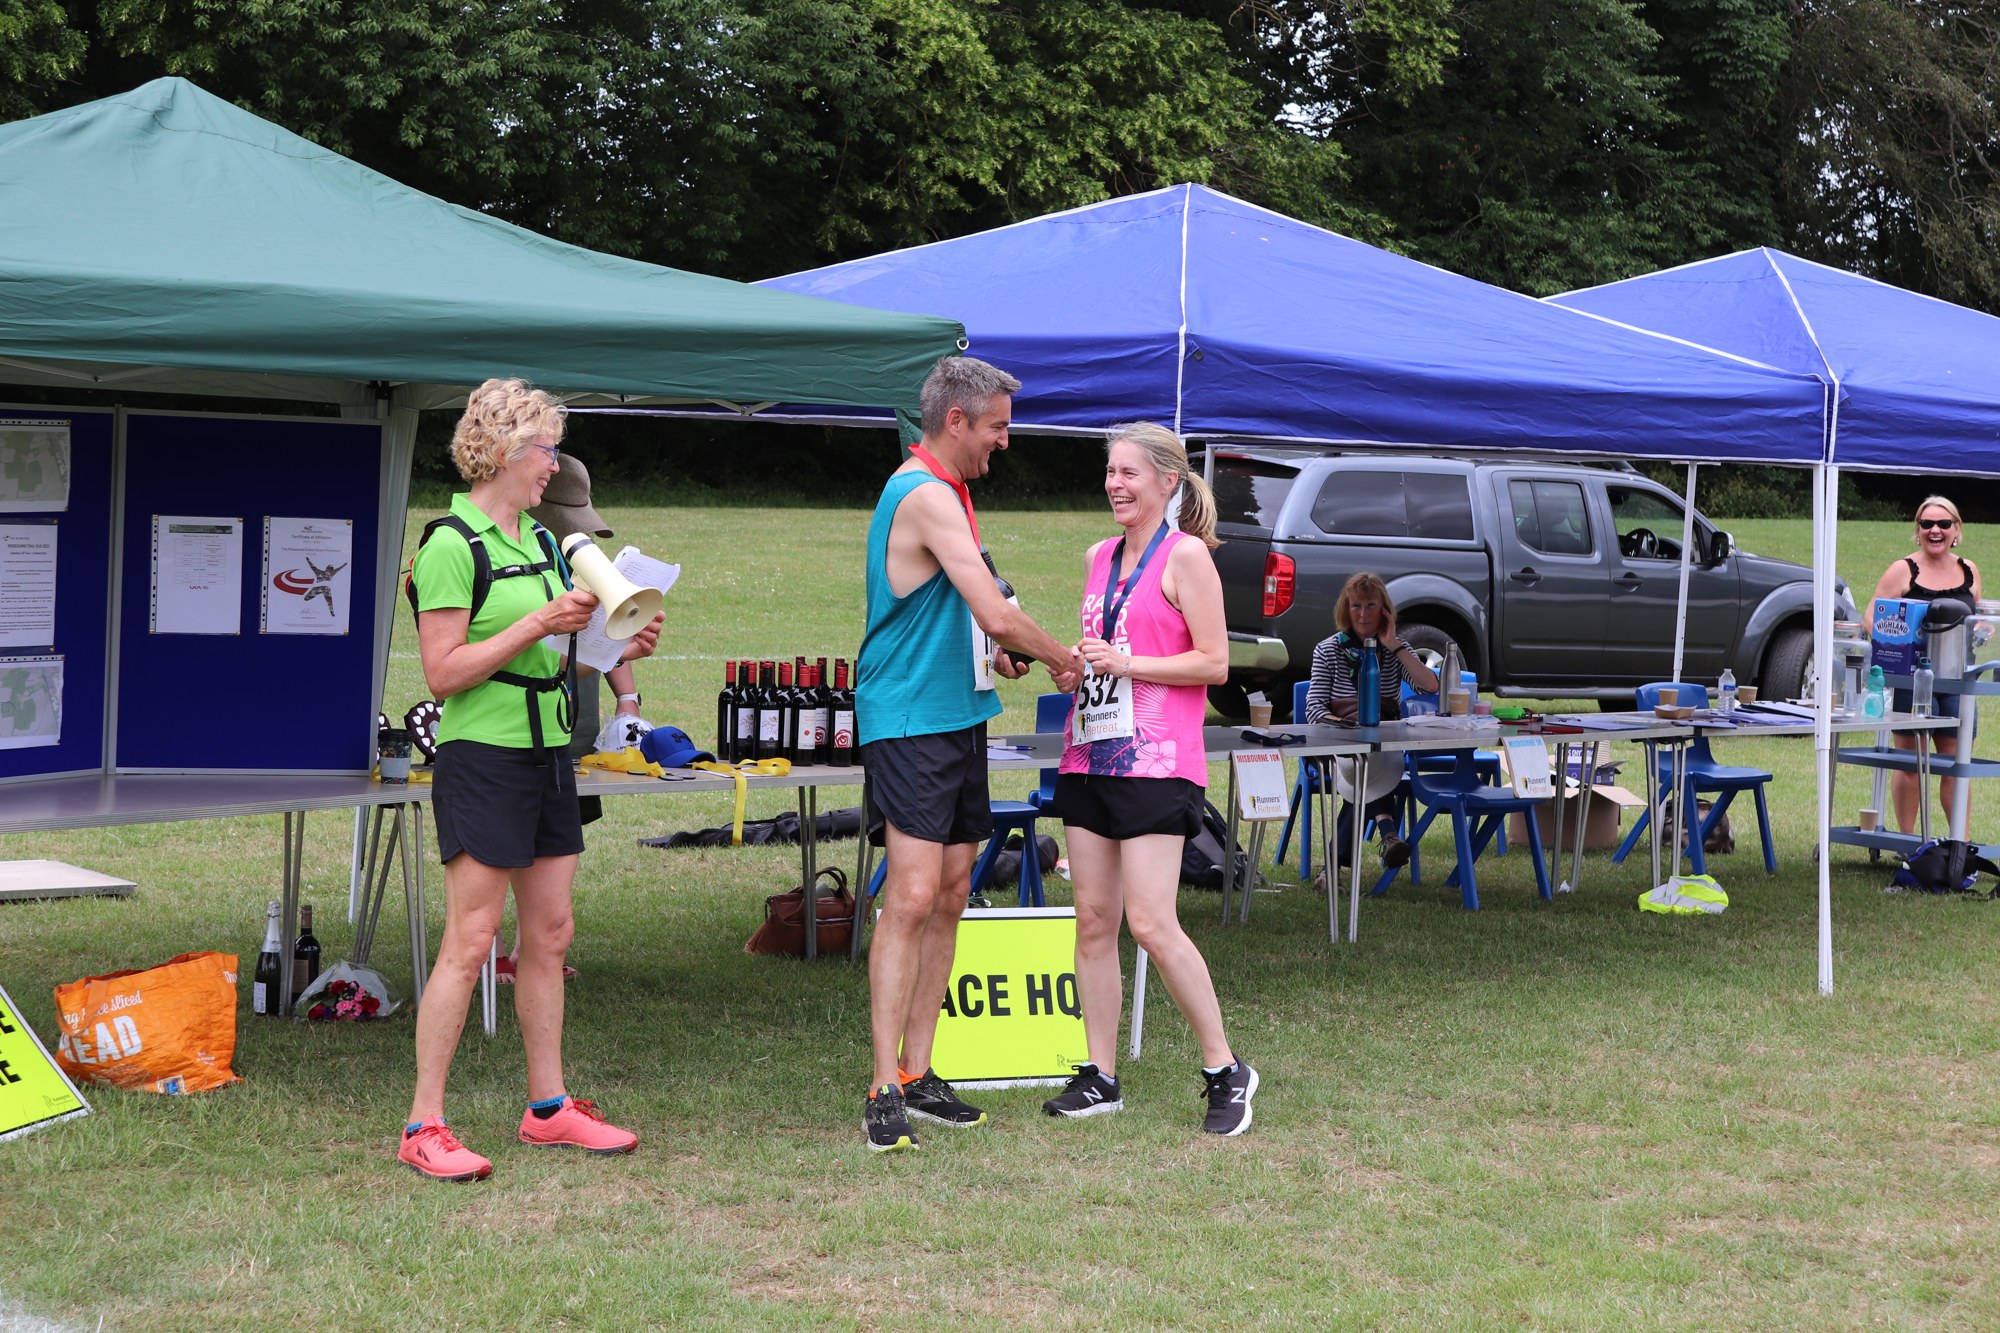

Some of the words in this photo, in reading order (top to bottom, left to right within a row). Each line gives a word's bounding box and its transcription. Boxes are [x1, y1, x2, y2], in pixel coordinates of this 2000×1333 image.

[1876, 621, 1909, 634] HIGHLAND
[1078, 672, 1119, 711] 532
[1086, 708, 1121, 724] Runners'
[1086, 721, 1118, 737] Retreat
[111, 989, 144, 1012] sliced
[940, 973, 1011, 1018] ACE
[1025, 972, 1083, 1021] HQ
[58, 1015, 143, 1064] READ
